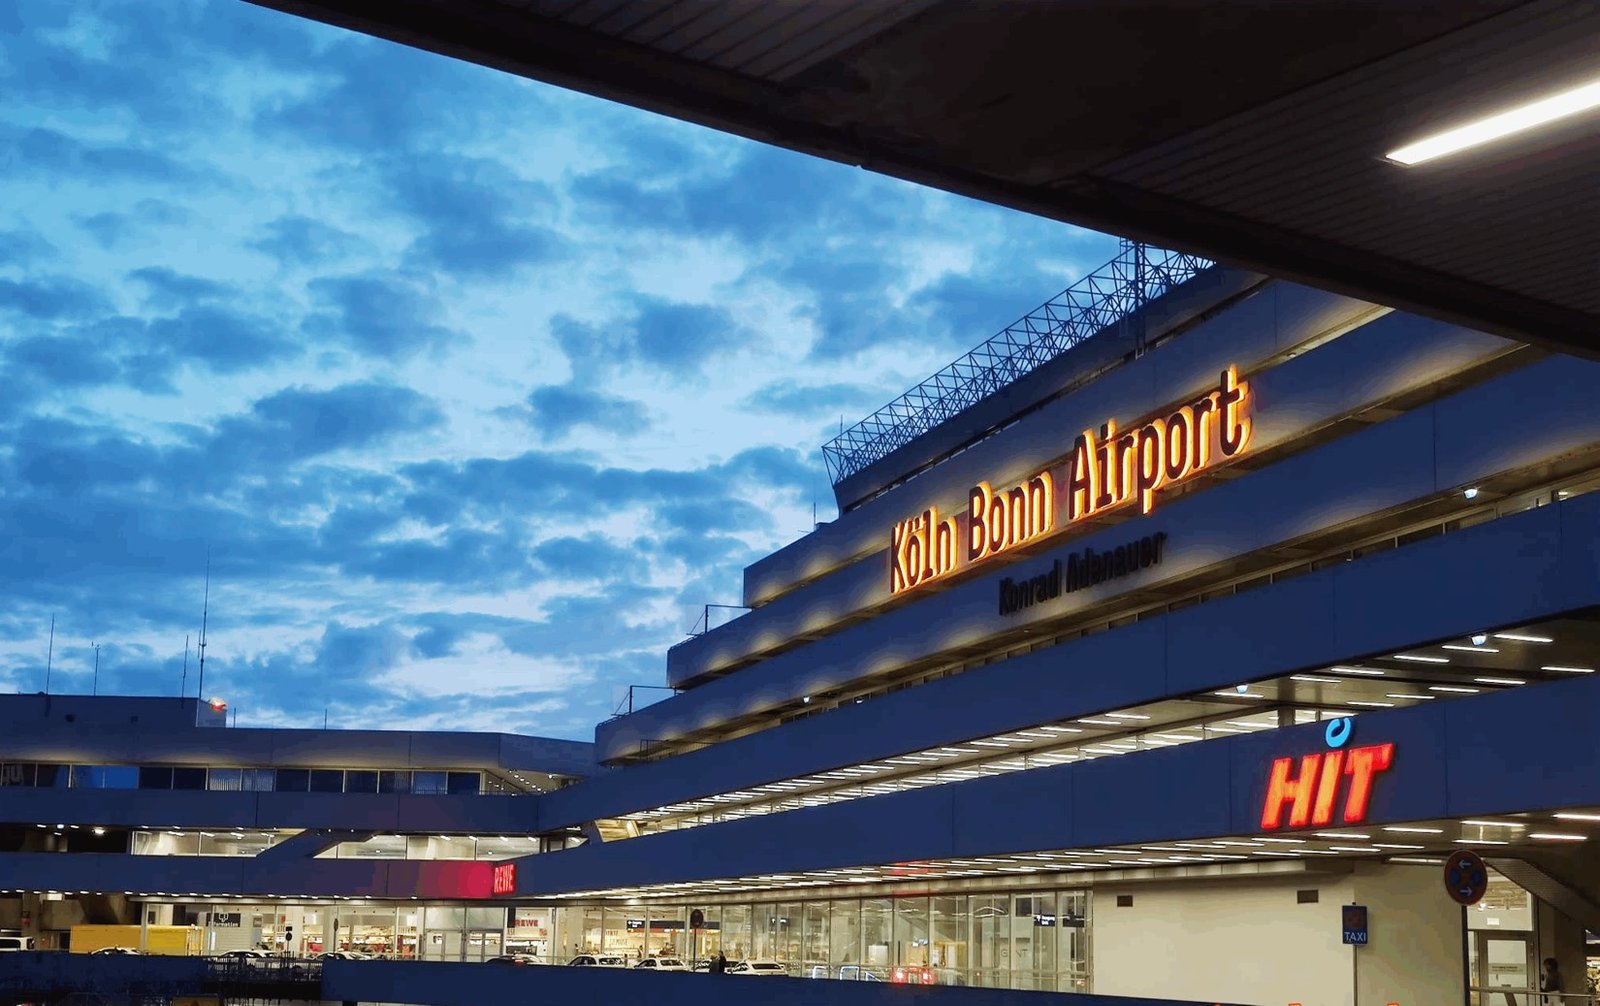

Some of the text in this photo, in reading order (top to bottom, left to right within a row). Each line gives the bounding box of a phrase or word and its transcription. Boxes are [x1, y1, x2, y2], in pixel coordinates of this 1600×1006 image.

[891, 363, 1252, 594] Köln Bonn Airport
[999, 558, 1062, 616] Konrad
[1261, 742, 1394, 829] HIT
[493, 864, 515, 894] REWE
[515, 919, 538, 927] REWE
[1344, 931, 1366, 942] TAXI
